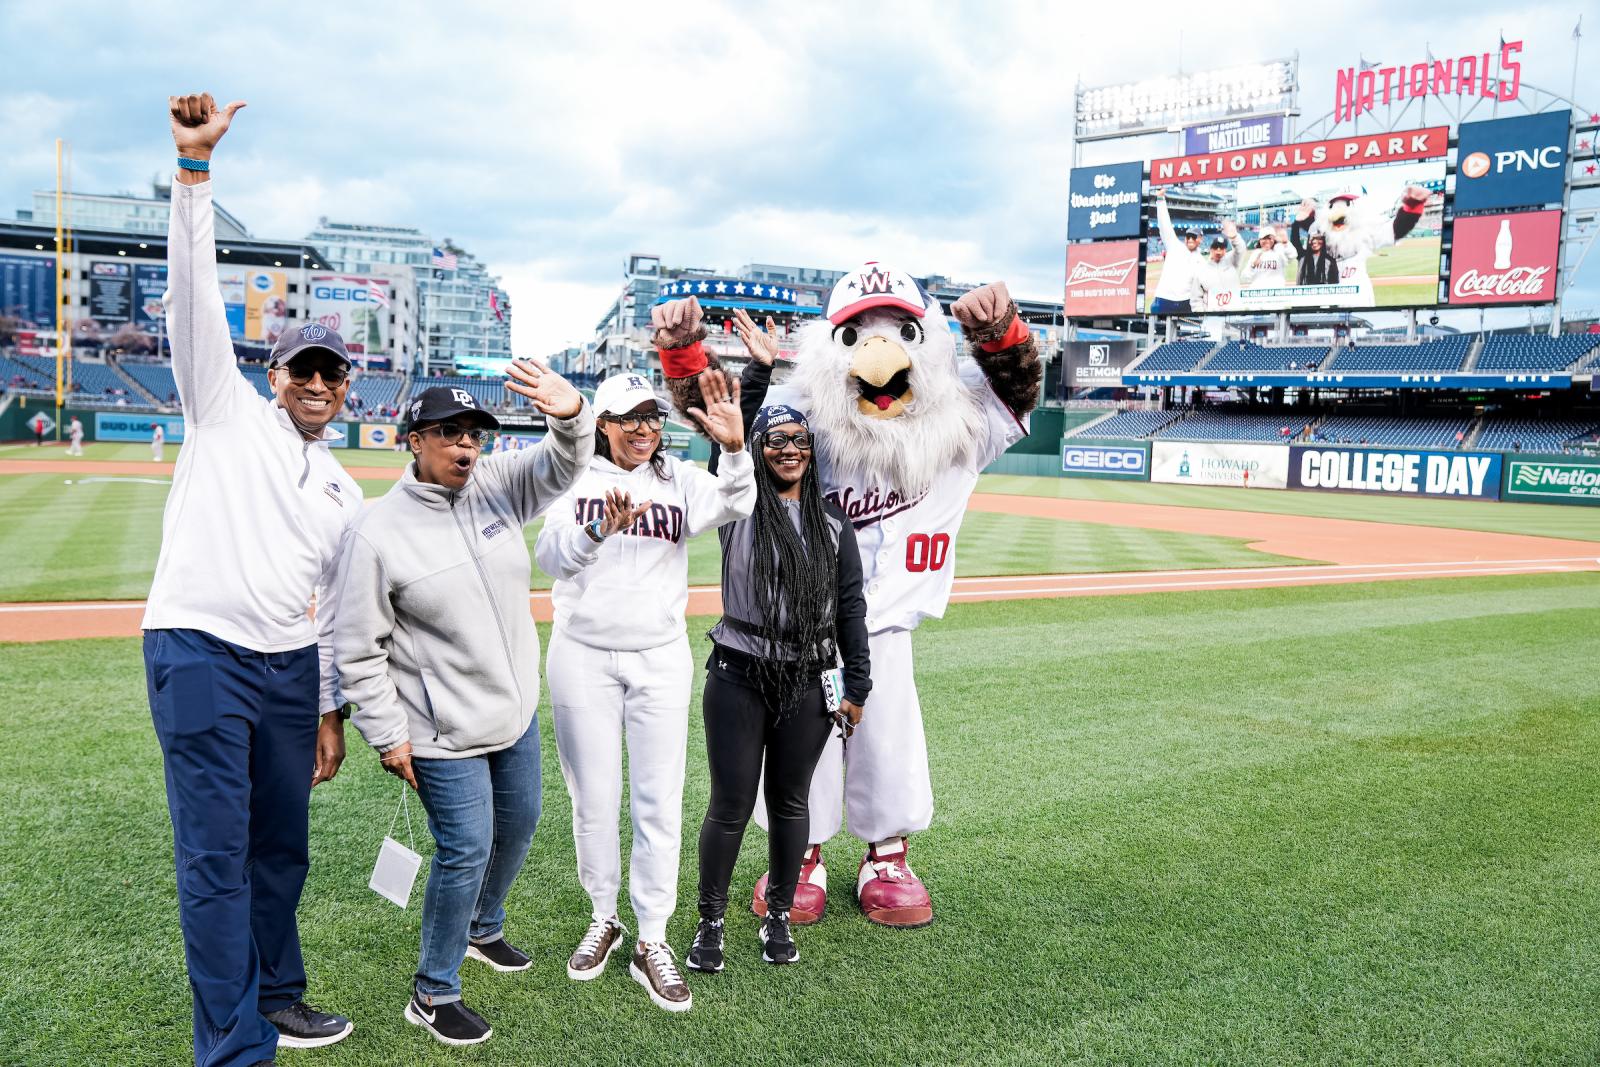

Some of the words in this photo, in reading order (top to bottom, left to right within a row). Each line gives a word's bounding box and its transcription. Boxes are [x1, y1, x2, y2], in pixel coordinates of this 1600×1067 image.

[1335, 40, 1523, 123] NATIONALS
[1209, 122, 1271, 151] NATITUDE
[1159, 145, 1327, 179] NATIONALS
[1344, 133, 1430, 160] PARK
[1495, 145, 1562, 174] PNC
[1093, 174, 1116, 189] The
[1070, 190, 1139, 209] Washington
[1089, 209, 1117, 228] Post
[860, 271, 890, 294] W
[1072, 265, 1130, 280] Budweiser
[1453, 265, 1551, 298] Coca-Cola
[314, 286, 378, 304] GEIC
[1071, 289, 1083, 298] THIS
[1104, 287, 1116, 297] FOR
[1076, 367, 1121, 377] BETMGM
[450, 388, 476, 409] DC
[101, 421, 128, 432] BUD
[129, 421, 167, 433] LIGT
[1065, 449, 1143, 470] GEICO
[1201, 458, 1260, 471] HOWARD
[1300, 449, 1420, 493] COLLEGE
[1425, 455, 1491, 496] DAY
[1569, 485, 1588, 495] Car
[575, 497, 683, 544] HOARD
[905, 532, 951, 573] 00
